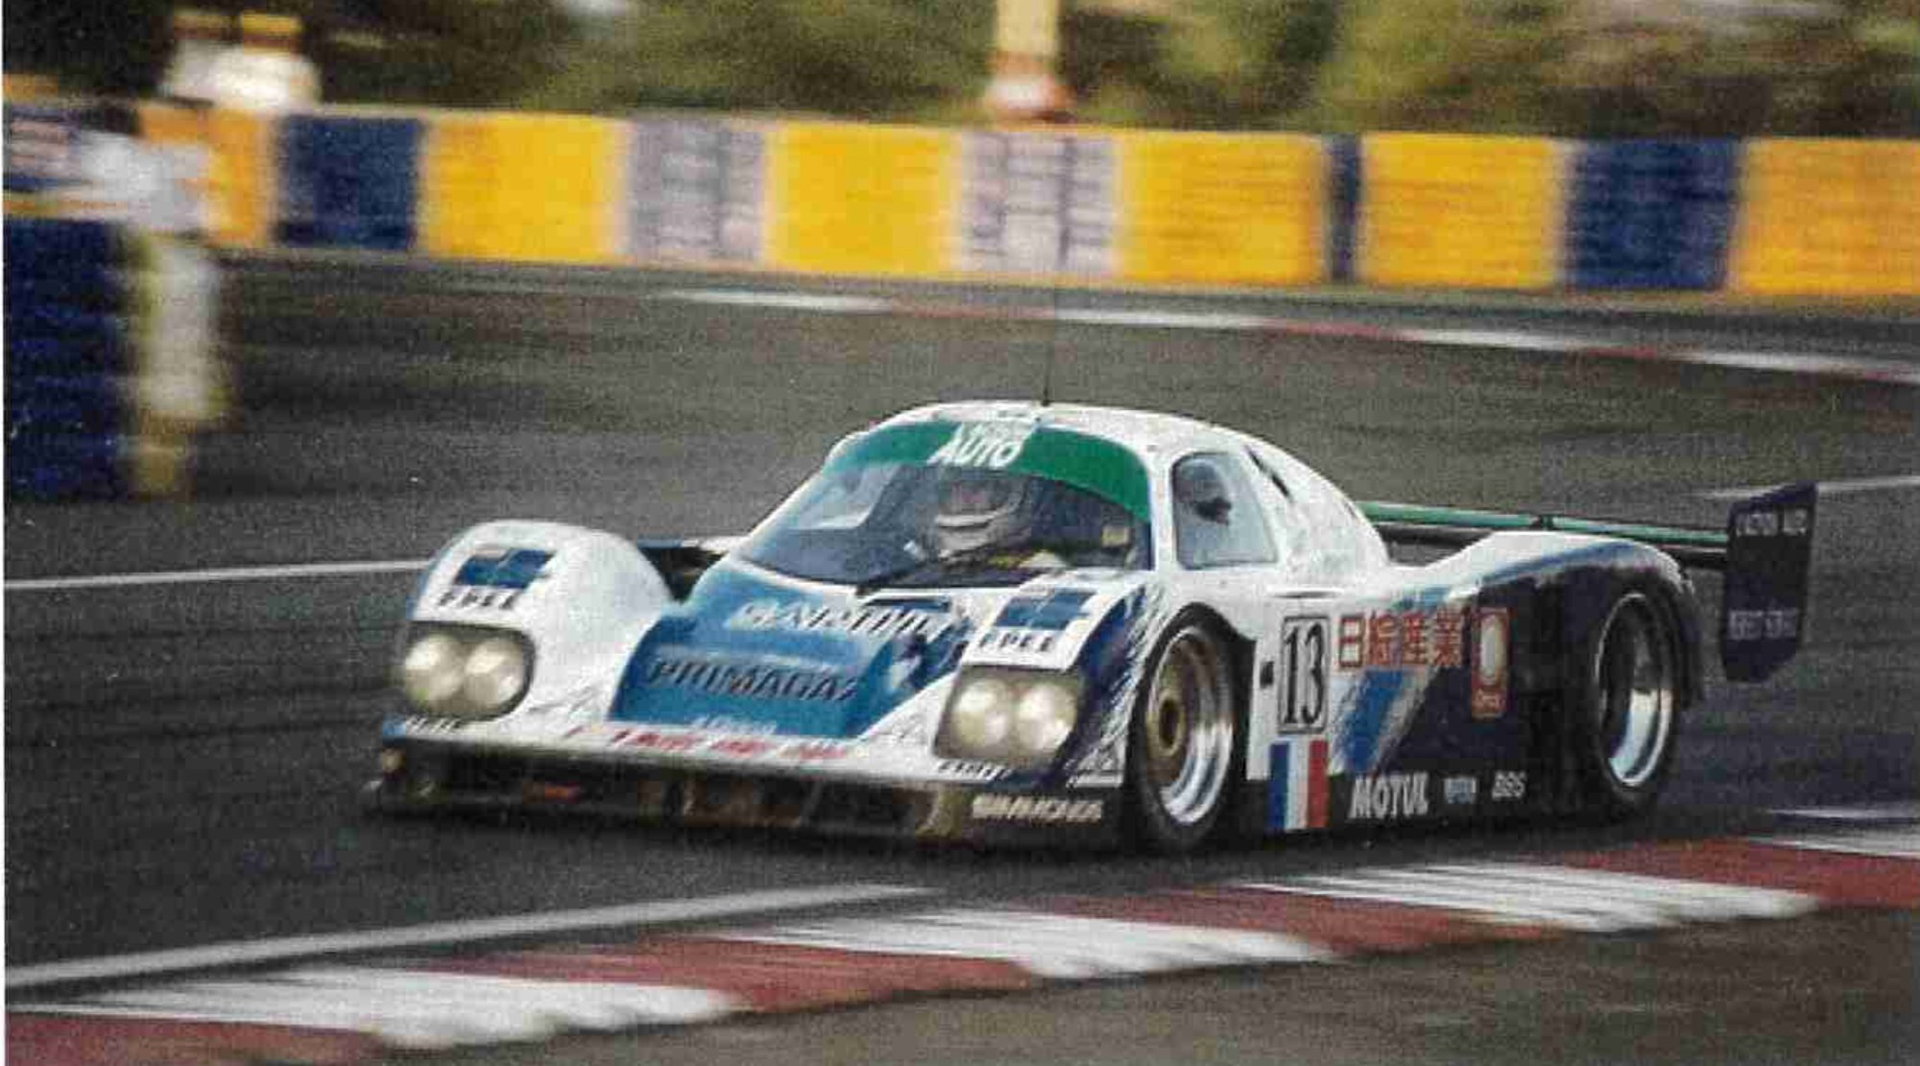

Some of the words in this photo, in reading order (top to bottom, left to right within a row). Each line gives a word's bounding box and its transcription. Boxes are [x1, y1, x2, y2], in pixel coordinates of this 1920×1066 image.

[926, 437, 1022, 469] AUTO
[1282, 622, 1324, 725] 13
[1349, 772, 1428, 819] MOTUL
